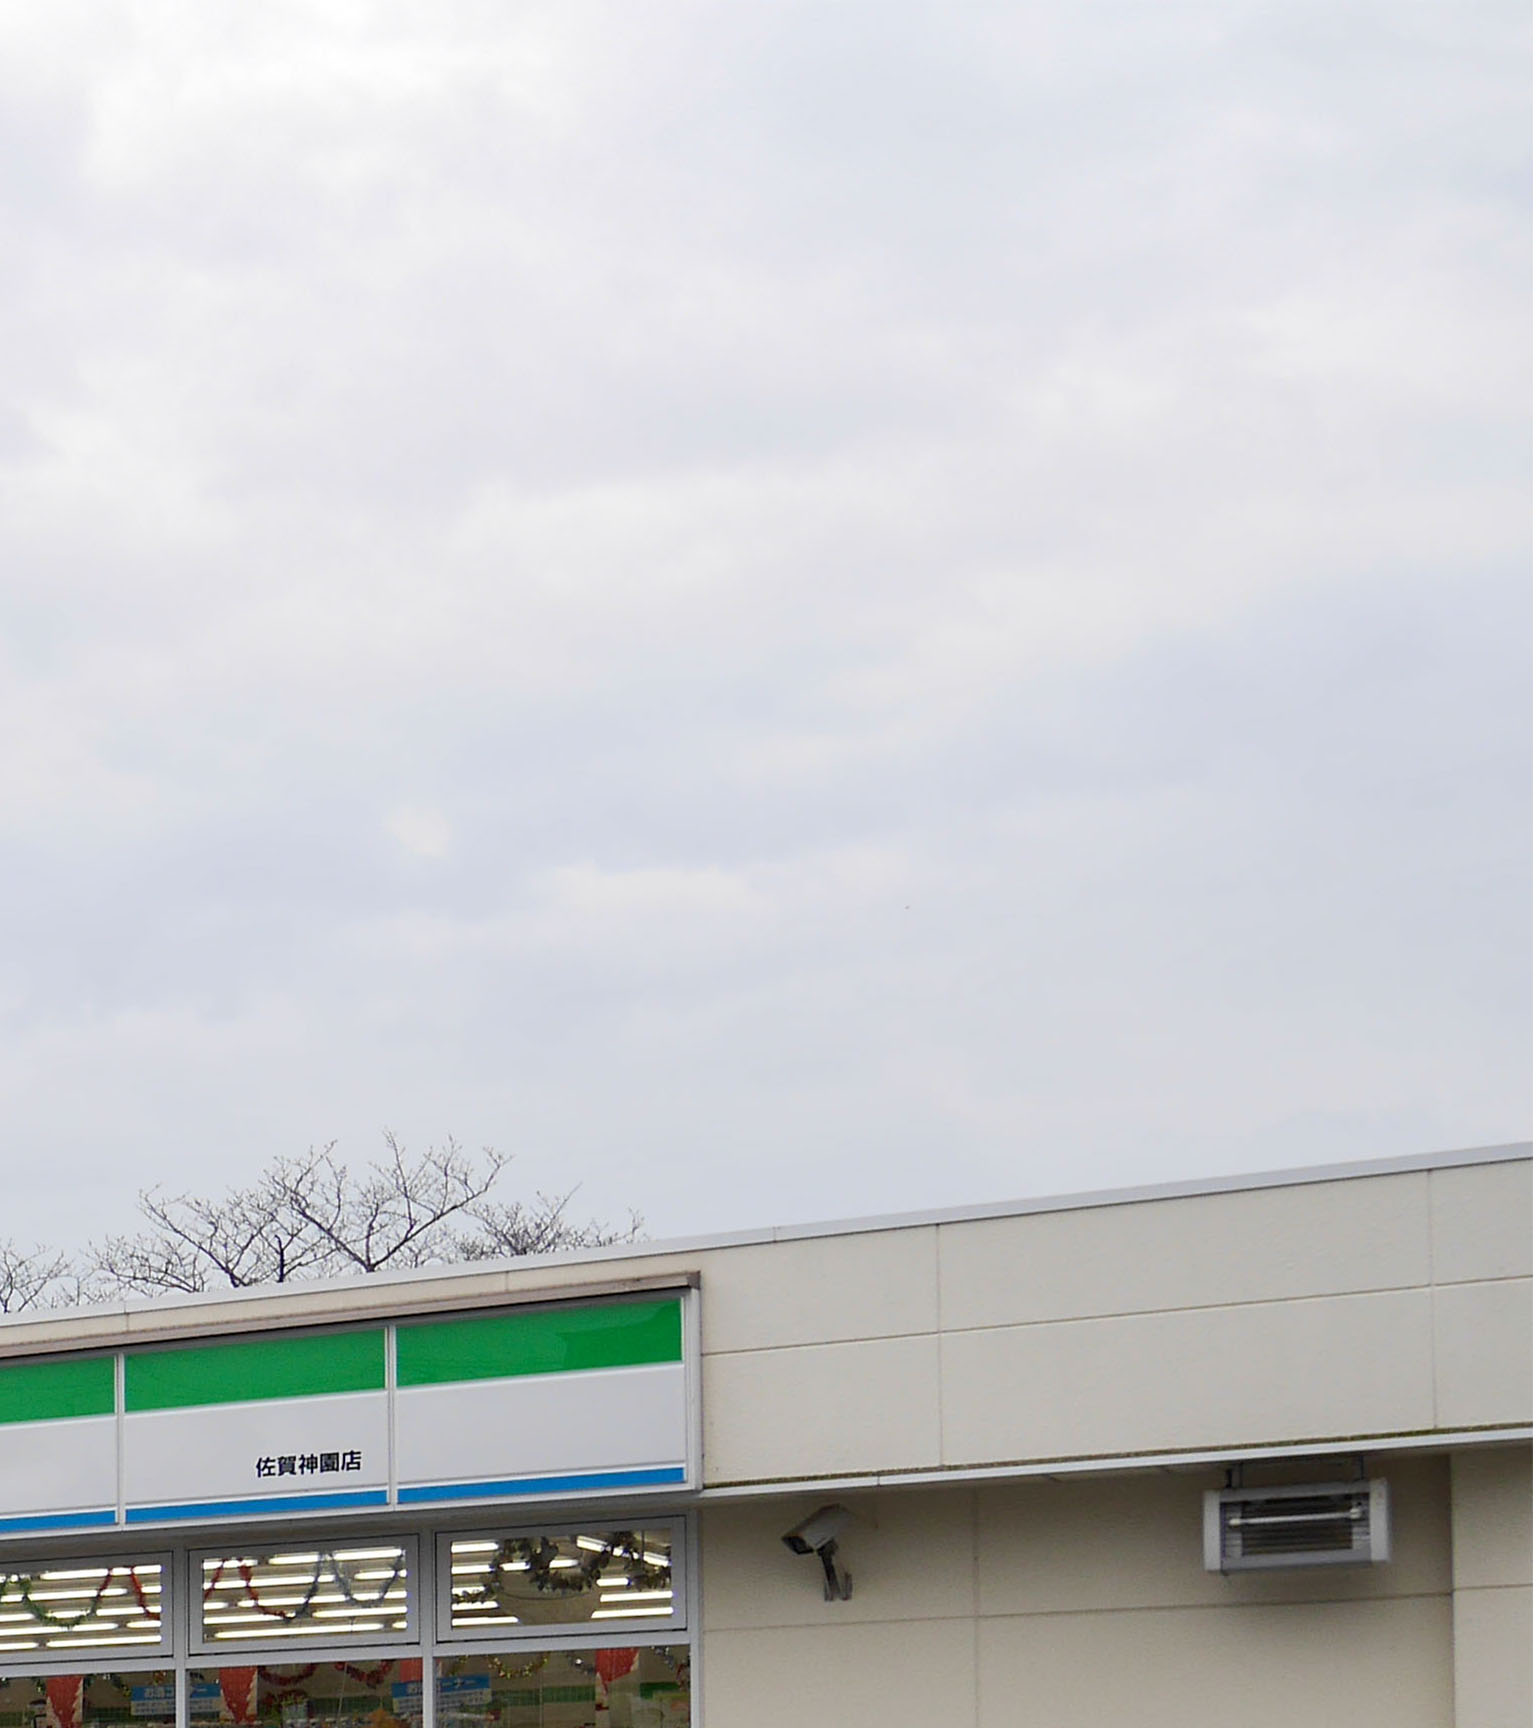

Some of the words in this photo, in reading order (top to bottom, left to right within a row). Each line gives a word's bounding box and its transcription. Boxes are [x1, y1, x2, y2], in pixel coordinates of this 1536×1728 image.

[256, 1450, 362, 1478] 佐賀神園店
